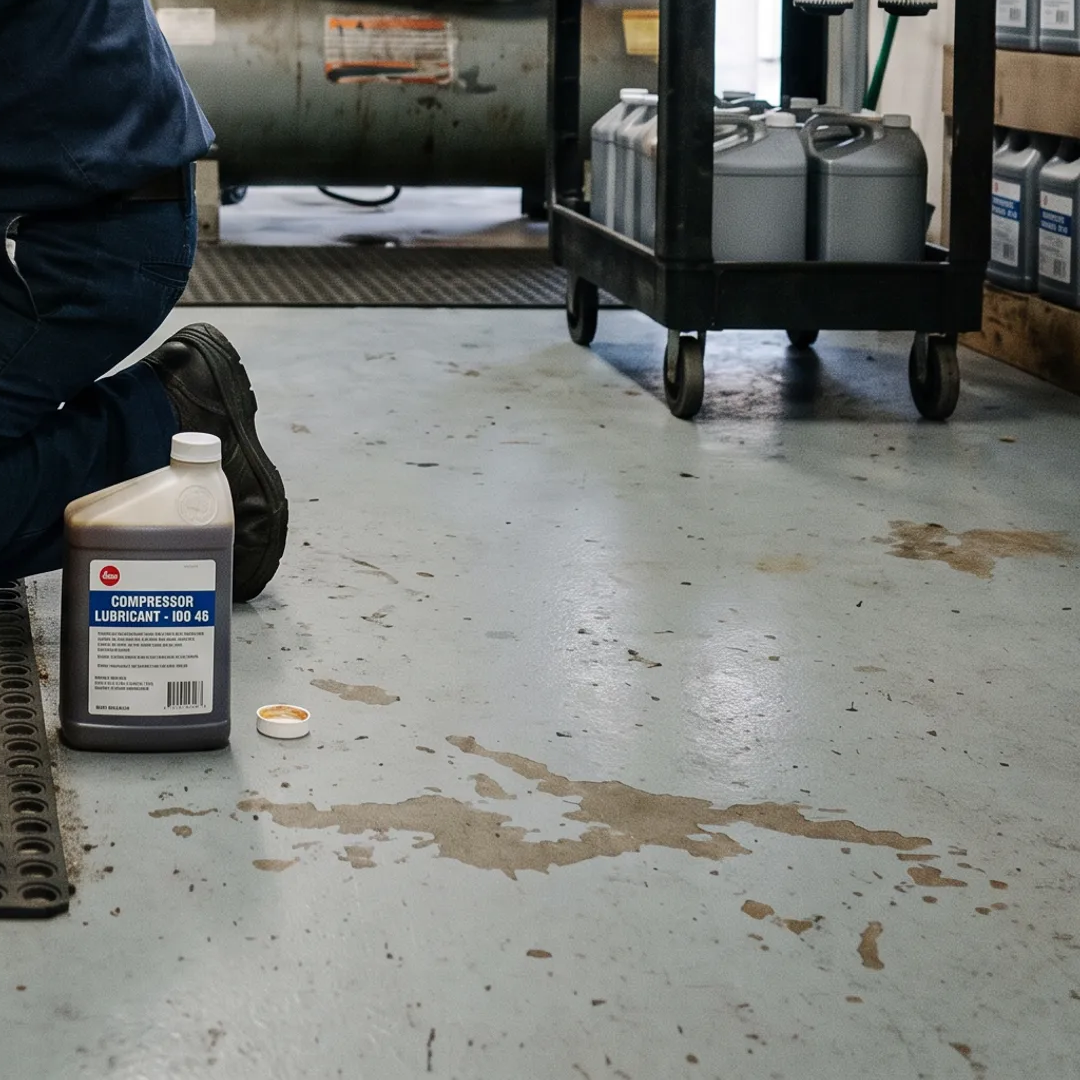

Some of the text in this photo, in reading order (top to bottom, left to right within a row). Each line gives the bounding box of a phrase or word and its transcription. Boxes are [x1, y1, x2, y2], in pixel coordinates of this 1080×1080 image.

[111, 595, 194, 608] COMPRESSOR
[95, 610, 161, 622] LUBRICANT
[194, 610, 209, 622] 46
